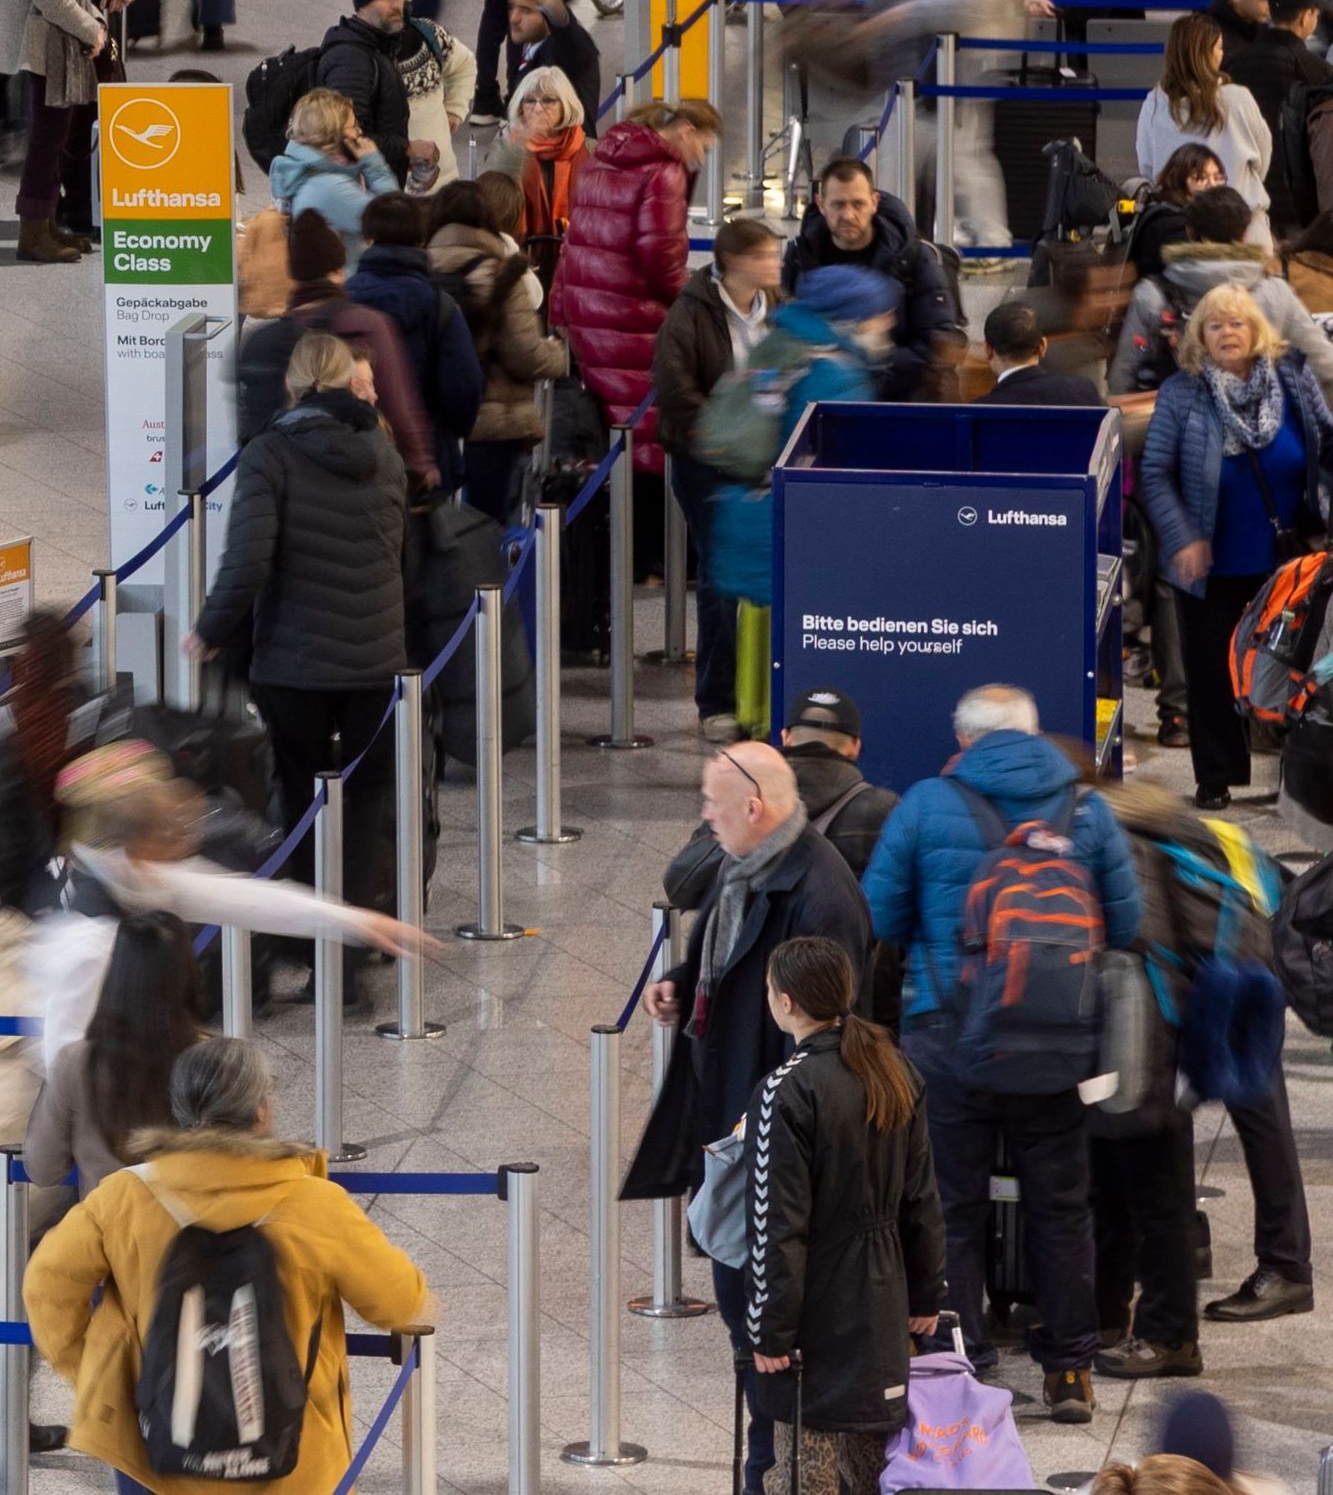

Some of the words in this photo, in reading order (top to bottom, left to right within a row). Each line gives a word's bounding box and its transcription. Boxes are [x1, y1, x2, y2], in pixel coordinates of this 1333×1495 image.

[112, 188, 221, 207] Lufthansa
[113, 232, 212, 252] Economy
[114, 253, 172, 271] Class
[117, 297, 207, 310] Gepäckabgabe
[117, 311, 139, 322] Bag
[142, 311, 169, 322] Drop
[117, 336, 137, 345] Mit
[117, 349, 141, 359] with
[988, 510, 1067, 526] Lufthansa
[803, 615, 844, 631] Bitte
[847, 616, 928, 634] bedienen
[931, 619, 959, 635] Sie
[962, 620, 998, 636] sich
[803, 635, 856, 651] Please
[860, 636, 894, 654] help
[898, 638, 962, 656] yourself
